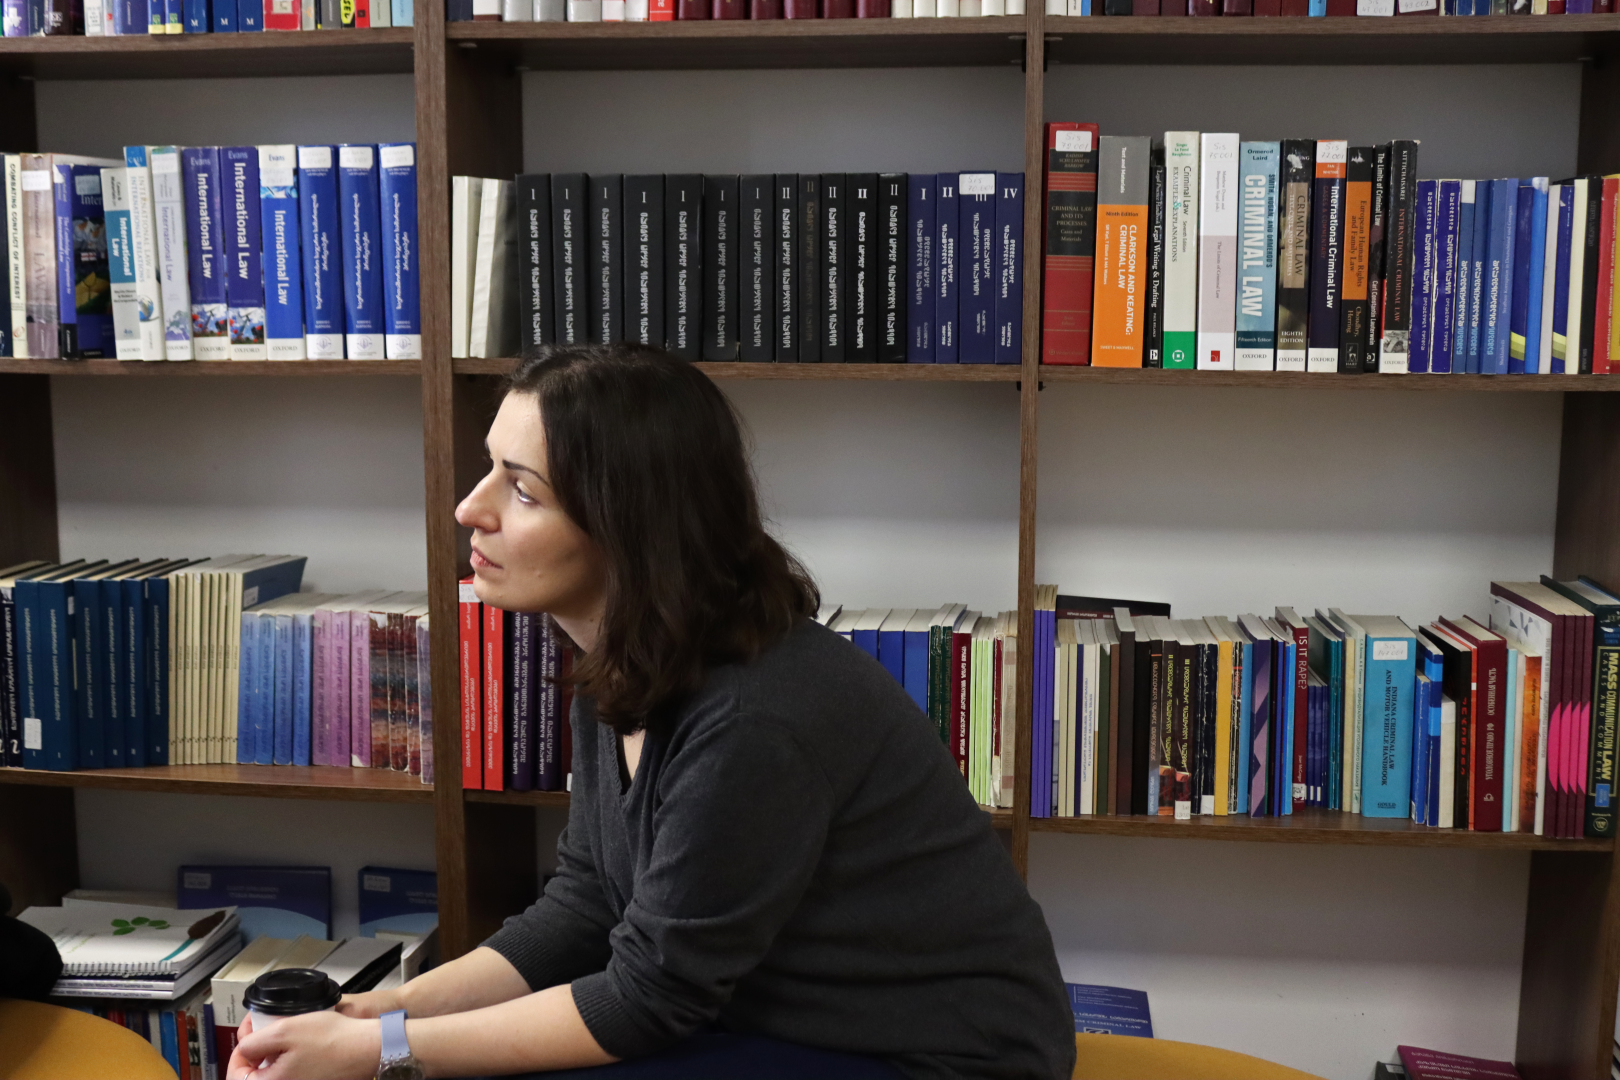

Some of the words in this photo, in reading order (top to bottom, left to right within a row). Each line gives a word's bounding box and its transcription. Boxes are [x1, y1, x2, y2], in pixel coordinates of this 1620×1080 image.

[190, 158, 211, 166] Evans
[228, 150, 248, 160] Evans
[9, 163, 18, 209] COMBATING
[1183, 166, 1192, 198] Criminal
[1267, 174, 1275, 195] SMITH,
[1399, 151, 1408, 201] KITTICHAISAREE
[234, 162, 250, 247] International
[942, 187, 953, 197] II
[1004, 188, 1018, 199] IV
[1375, 190, 1383, 213] Criminal
[131, 176, 142, 239] INTERNATIONAL
[138, 176, 150, 246] INTERNATIONAL
[197, 173, 212, 250] International
[1183, 200, 1191, 215] Law
[1266, 197, 1274, 218] HOGAN,
[1328, 186, 1340, 246] International
[1358, 201, 1367, 234] European
[1374, 215, 1382, 226] Law
[162, 207, 173, 262] International
[530, 209, 538, 238] ნაწილი
[1152, 226, 1161, 243] Legal
[1243, 175, 1266, 270] CRIMINAL
[1296, 195, 1306, 251] CRIMINAL
[112, 238, 120, 257] Law
[120, 218, 131, 276] International
[275, 210, 288, 281] International
[531, 240, 539, 264] კერძო
[1118, 225, 1128, 267] CRIMINAL
[1127, 225, 1137, 272] CLARKSON
[1266, 234, 1274, 268] ORMEROD'S
[1349, 231, 1357, 255] Family
[1358, 236, 1366, 262] Human
[1396, 209, 1405, 266] INTERNATIONAL
[13, 251, 19, 261] OF
[136, 241, 145, 282] RELATIONS
[201, 254, 213, 278] Law
[238, 252, 250, 279] Law
[1152, 244, 1160, 269] Writing
[1295, 254, 1304, 275] LAW
[1327, 248, 1336, 286] Criminal
[166, 264, 174, 281] Law
[1118, 269, 1126, 288] LAW
[1127, 274, 1135, 293] AND
[1356, 265, 1364, 287] Rights
[1394, 269, 1402, 304] CRIMINAL
[278, 283, 289, 305] Law
[532, 267, 541, 309] სამართლის
[1151, 280, 1159, 308] Drafting
[1241, 276, 1263, 316] LAW
[1326, 289, 1335, 308] Law
[1125, 295, 1134, 335] KEATING:
[1370, 292, 1378, 317] Constantin
[533, 313, 541, 344] სისხლის
[1345, 310, 1354, 333] Herring
[1299, 636, 1307, 644] IS
[1299, 648, 1307, 657] IT
[1298, 660, 1306, 689] RAPE?
[1488, 668, 1496, 684] ЧАСТЬ
[1601, 652, 1609, 686] CASES
[1607, 652, 1619, 689] MASS
[1487, 685, 1496, 715] ОСОБЕННАЯ
[1486, 723, 1494, 731] РФ
[1603, 691, 1616, 749] COMMUNICATION
[1486, 733, 1494, 749] ПРАВО
[1595, 725, 1604, 780] COMMENT
[1485, 749, 1494, 780] УГОЛОВНОЕ
[1602, 751, 1611, 780] LAW
